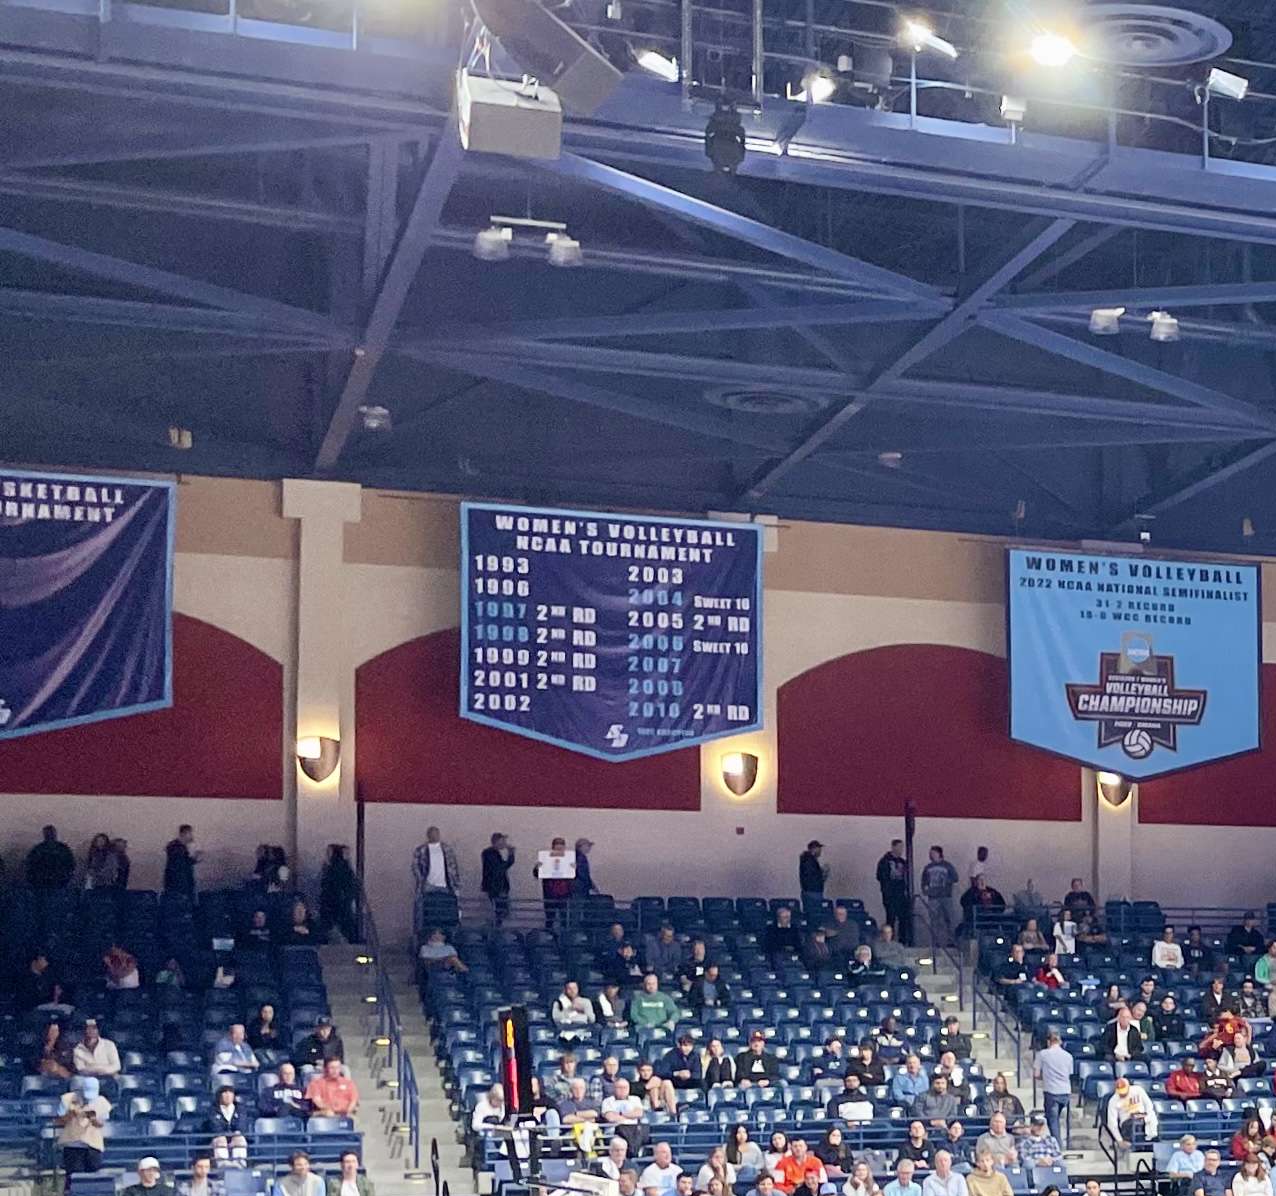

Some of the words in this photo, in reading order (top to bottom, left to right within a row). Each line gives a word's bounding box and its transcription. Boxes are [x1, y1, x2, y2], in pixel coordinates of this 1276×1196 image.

[1, 500, 116, 523] RNAMENT
[495, 514, 598, 537] WOMEN'S
[608, 523, 736, 547] VOLLEYBALL
[516, 535, 572, 554] NCAA
[579, 539, 713, 563] TOURNAMENT
[475, 554, 529, 574] 1993
[1025, 556, 1119, 577] WOMEN'S
[1128, 563, 1243, 585] VOLLEYBALL
[628, 565, 684, 584] 2003
[628, 588, 683, 606] 2004
[1019, 577, 1053, 589] 2022
[1057, 579, 1093, 592] NCAA
[1097, 582, 1158, 596] NATIONAL
[1162, 587, 1249, 601] SEMIFINALIST
[572, 606, 597, 624] RD
[628, 610, 684, 629] 2005
[727, 616, 750, 632] RD
[572, 629, 597, 646] RD
[572, 652, 597, 669] RD
[628, 656, 682, 674] 2007
[474, 669, 528, 689] 2001
[572, 675, 597, 692] RD
[1105, 682, 1169, 697] VOLLEYBALL
[474, 692, 531, 711] 2002
[628, 701, 680, 718] 2010
[727, 704, 750, 721] RD
[1077, 694, 1199, 716] CHAMPIONSHIP
